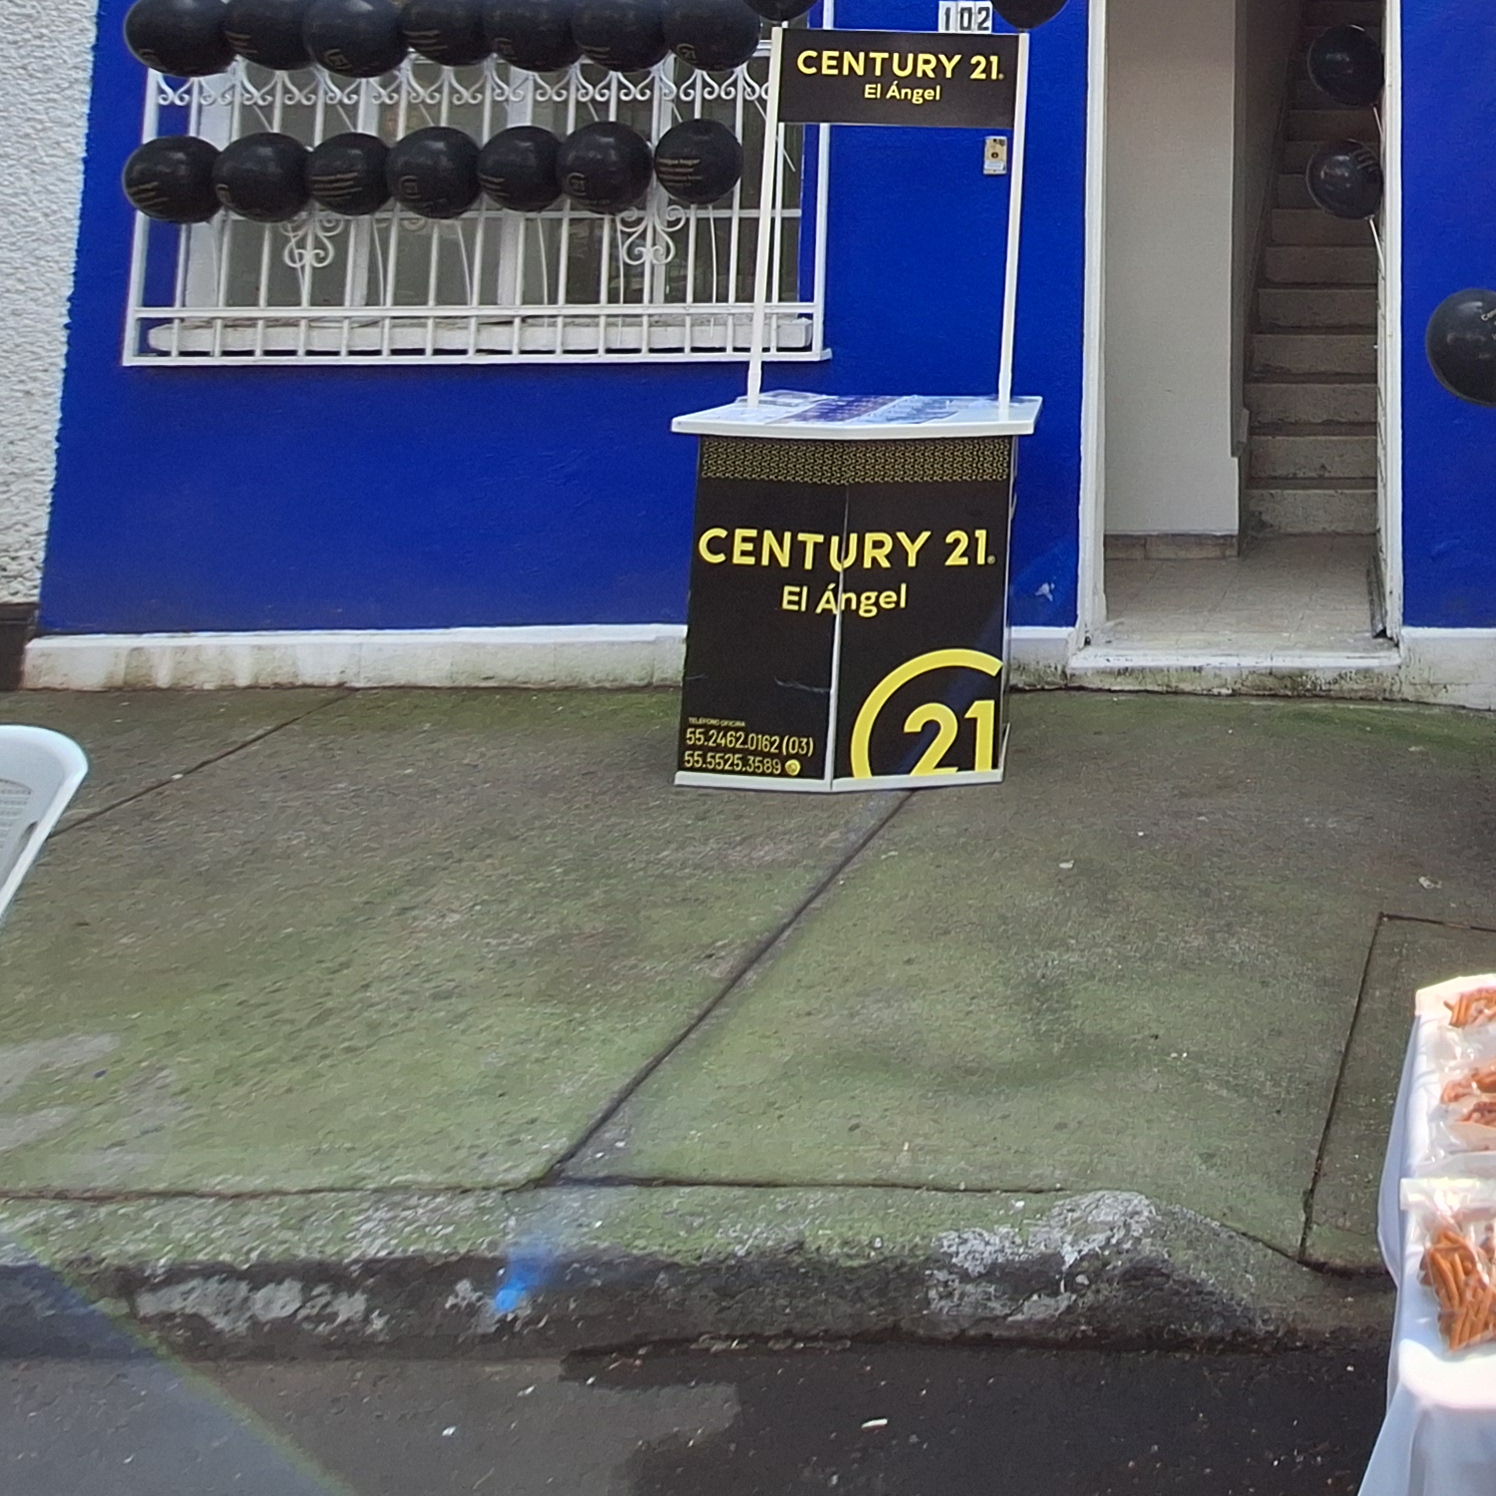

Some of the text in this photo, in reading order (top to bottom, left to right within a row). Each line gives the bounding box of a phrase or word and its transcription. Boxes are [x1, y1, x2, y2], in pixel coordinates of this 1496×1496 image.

[944, 6, 990, 32] 102
[797, 50, 962, 79] CENTURY
[864, 80, 941, 104] El Ángel
[698, 527, 931, 572] CENTURY
[781, 583, 907, 618] El Ángel
[686, 727, 814, 757] 55.2462.0162 (03)
[684, 750, 782, 775] 55.5525.3589
